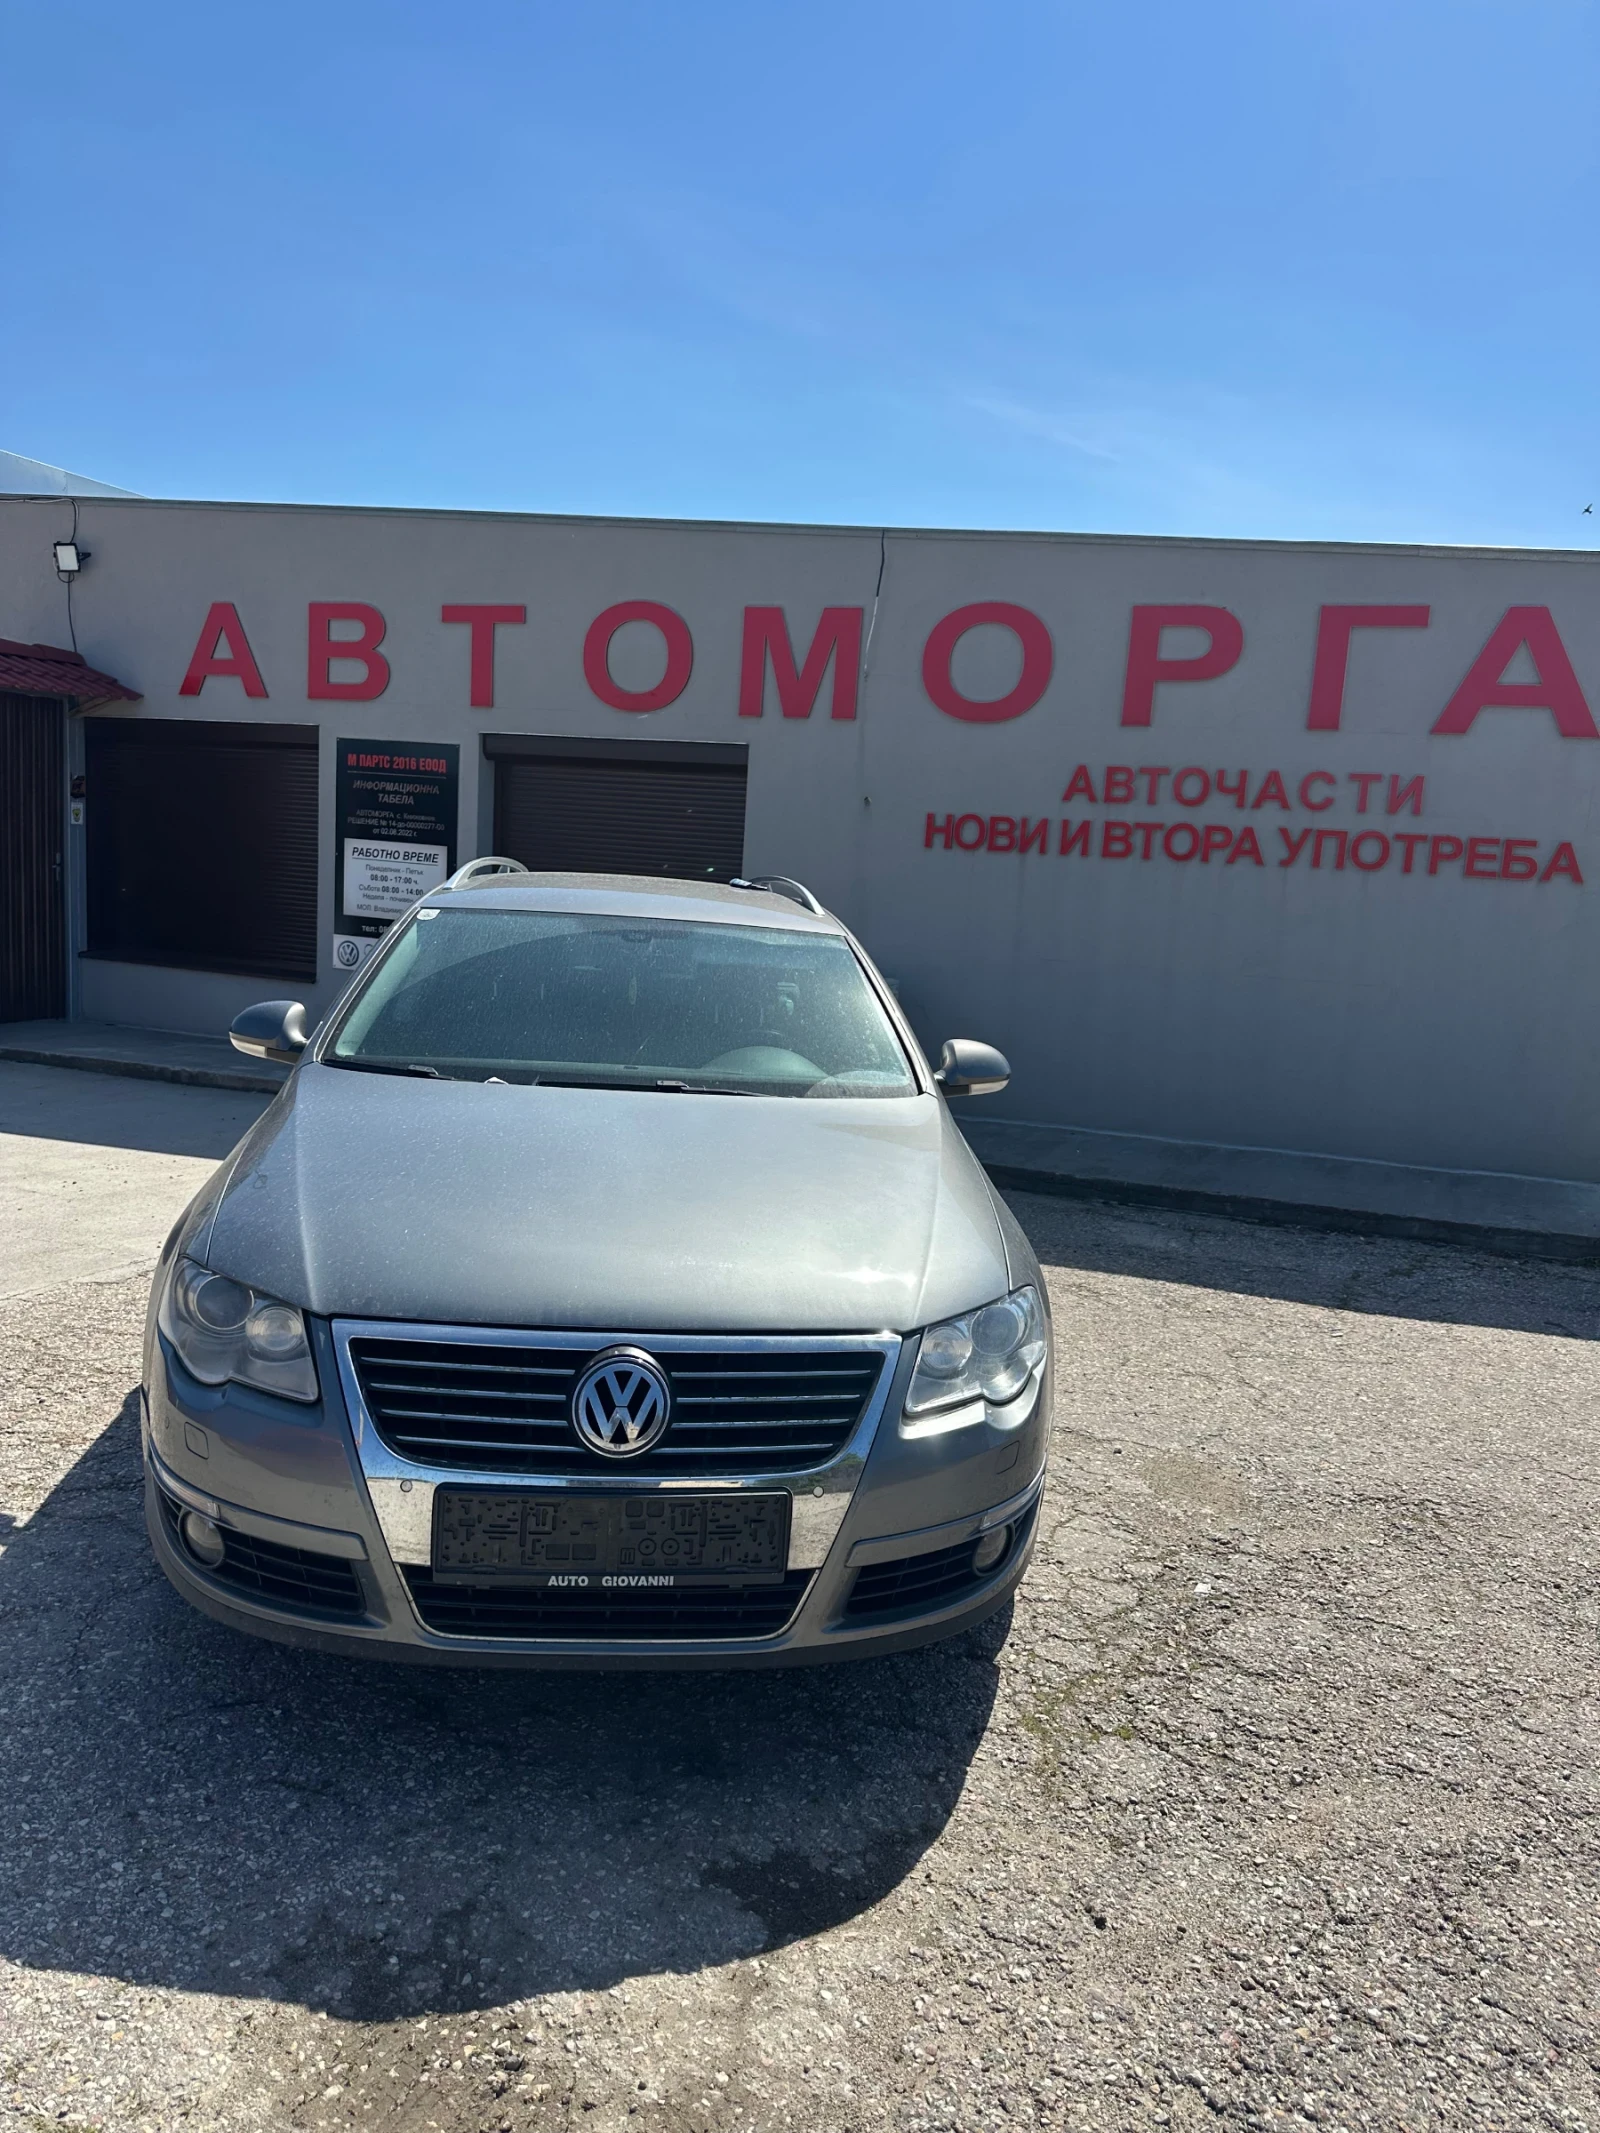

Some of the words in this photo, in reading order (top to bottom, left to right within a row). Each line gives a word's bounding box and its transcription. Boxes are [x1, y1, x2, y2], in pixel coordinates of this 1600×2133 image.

[179, 600, 1600, 739] АВТОМОРГА
[347, 753, 357, 766] М
[359, 754, 391, 768] ПАРТС
[393, 756, 417, 770] 2016
[419, 758, 447, 773] ЕООД
[353, 780, 440, 795] ИНФОРМАЦИОННА
[1061, 764, 1426, 816] АВТОЧАСТИ
[378, 793, 415, 805] ТАБЕЛА
[356, 809, 394, 819] АВТОМОРГА
[347, 816, 379, 827] РЕШЕНИЕ
[352, 846, 400, 860] РАБОТНО
[402, 851, 439, 863] ВРЕМЕ
[924, 812, 1049, 855] НОВИ
[1059, 819, 1091, 857] И
[1101, 820, 1264, 866] ВТОРА
[1278, 825, 1584, 885] УПОТРЕБА
[365, 864, 401, 873] Понеделник
[405, 867, 424, 875] Петък
[370, 874, 389, 882] 08:00
[394, 876, 413, 885] 17:00
[358, 884, 380, 892] Събота
[381, 886, 400, 894] 08:00
[547, 1575, 589, 1587] AUTO
[601, 1575, 675, 1587] GIOVANNI
